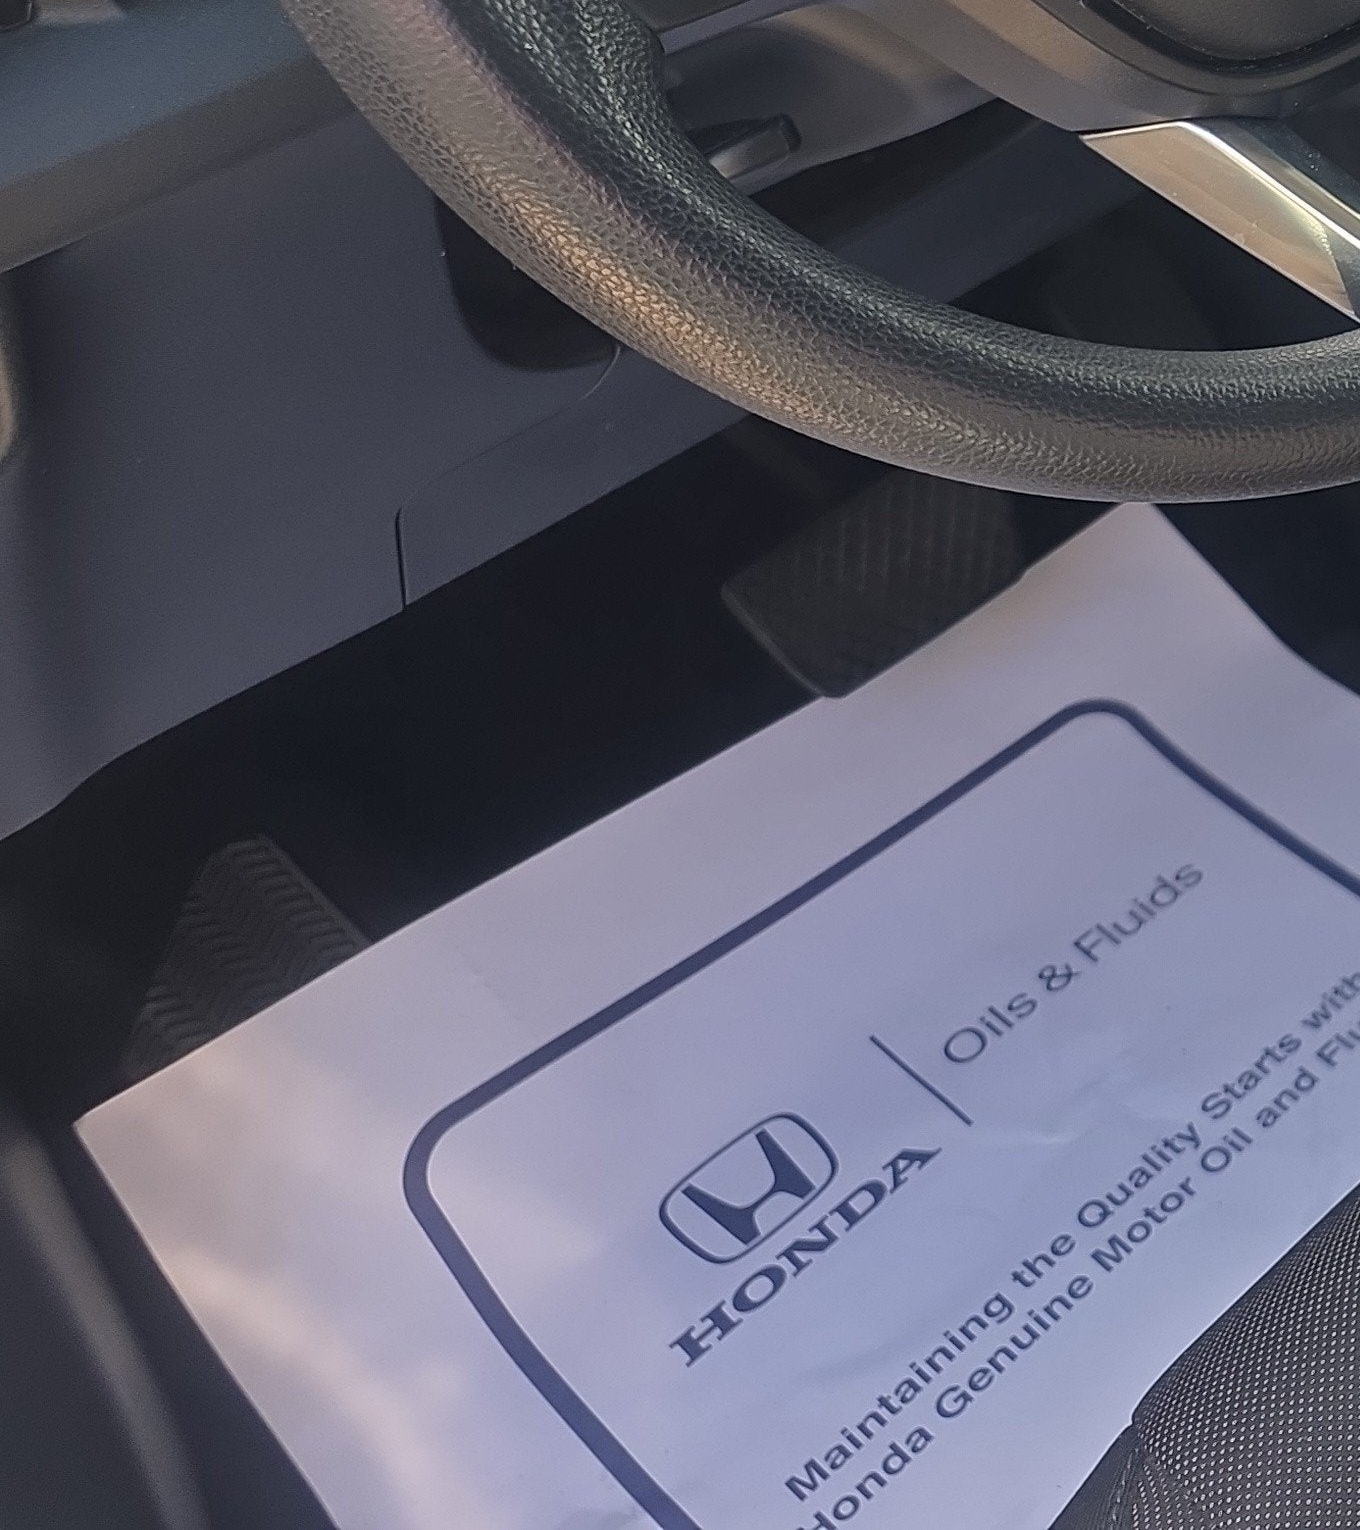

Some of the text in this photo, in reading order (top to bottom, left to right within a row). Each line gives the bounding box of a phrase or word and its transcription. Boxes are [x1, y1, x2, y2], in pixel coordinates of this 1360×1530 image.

[943, 863, 1204, 1065] Oils & Fluids
[669, 1147, 943, 1368] HONDA
[784, 1290, 1016, 1502] Maintaining
[1011, 1233, 1076, 1289] the
[1078, 1122, 1202, 1228] Quality
[1200, 1034, 1302, 1120] Starts
[935, 1274, 1095, 1419] Genuine
[1091, 1176, 1197, 1272] Motor
[1200, 1127, 1253, 1173] Oil
[1256, 1067, 1319, 1128] and
